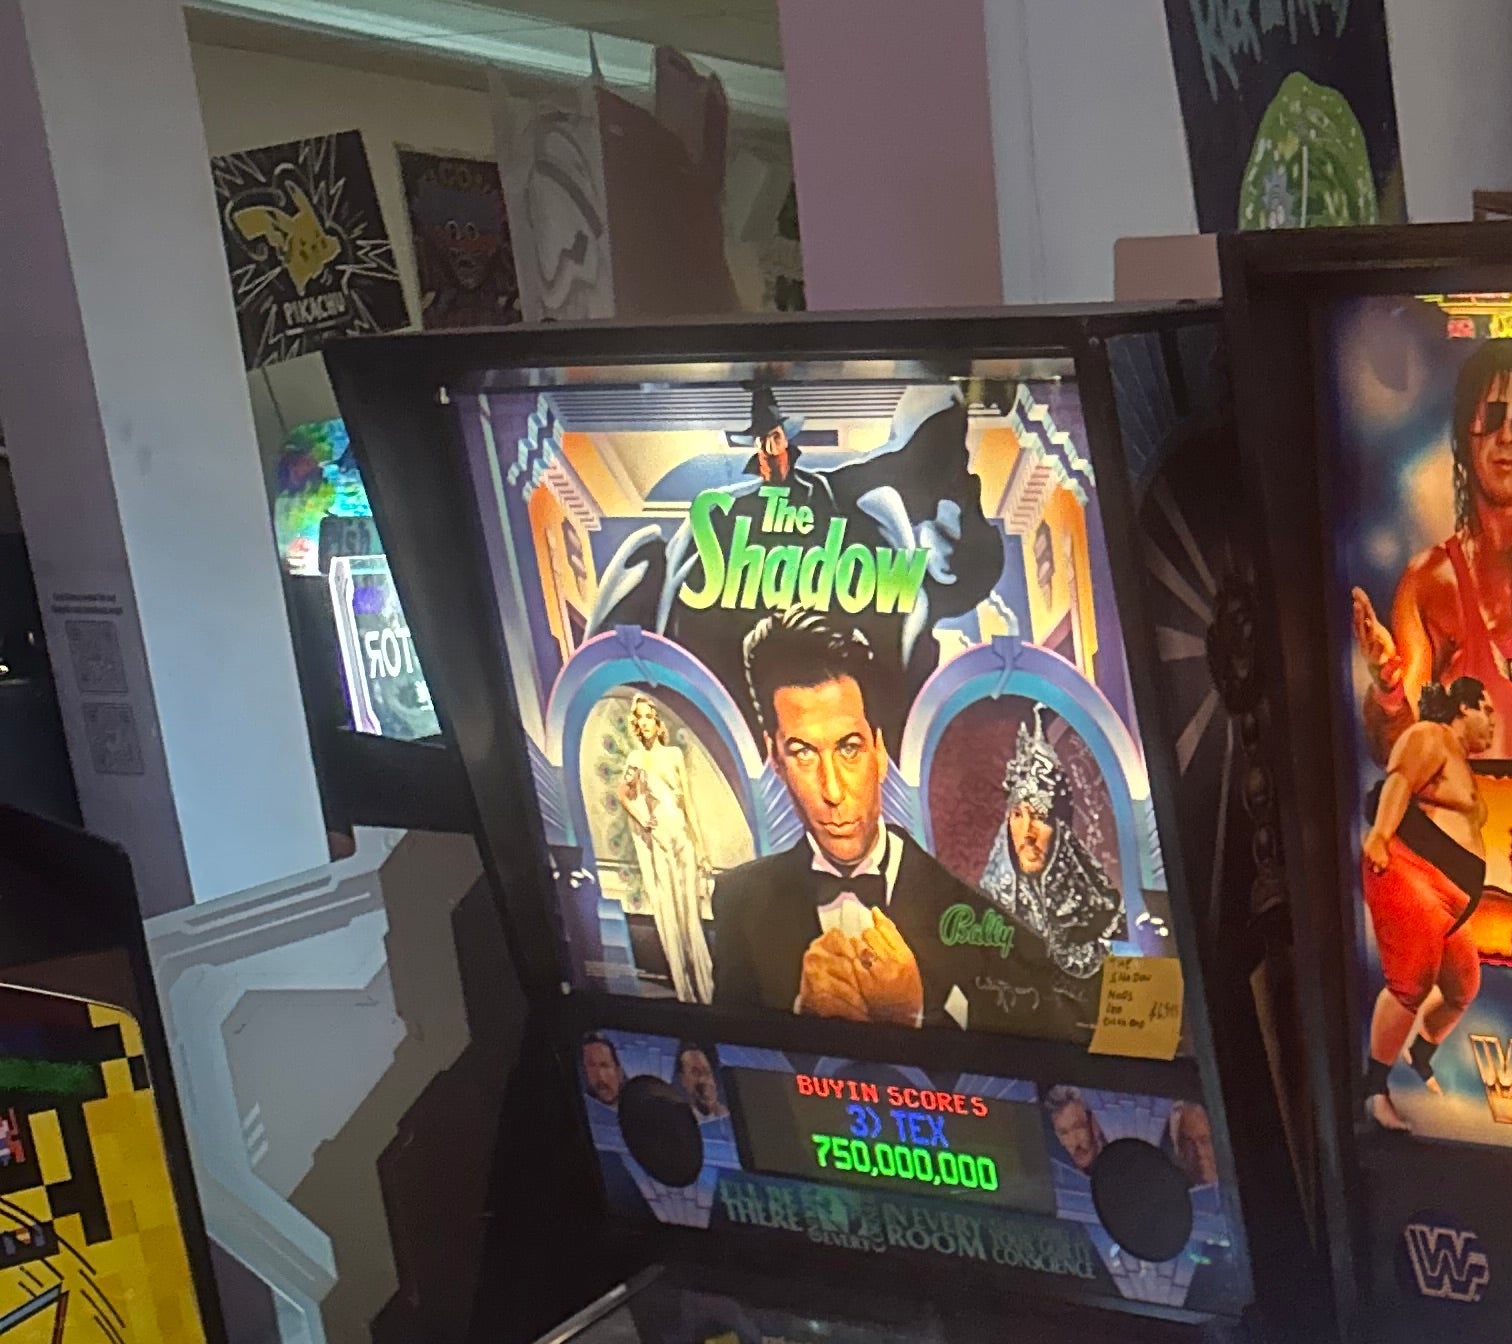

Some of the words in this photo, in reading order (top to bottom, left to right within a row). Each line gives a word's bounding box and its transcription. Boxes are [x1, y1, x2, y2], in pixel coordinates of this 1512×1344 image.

[284, 292, 346, 325] PIKACHU
[758, 486, 815, 534] The
[679, 488, 931, 614] Shadow
[940, 903, 1015, 959] Bally
[796, 1074, 879, 1103] BUYIN
[887, 1086, 989, 1117] SCORES
[847, 1104, 882, 1138] 3)
[890, 1109, 950, 1148] TEX
[811, 1134, 999, 1191] 750,000,000
[886, 1224, 988, 1260] ROOM
